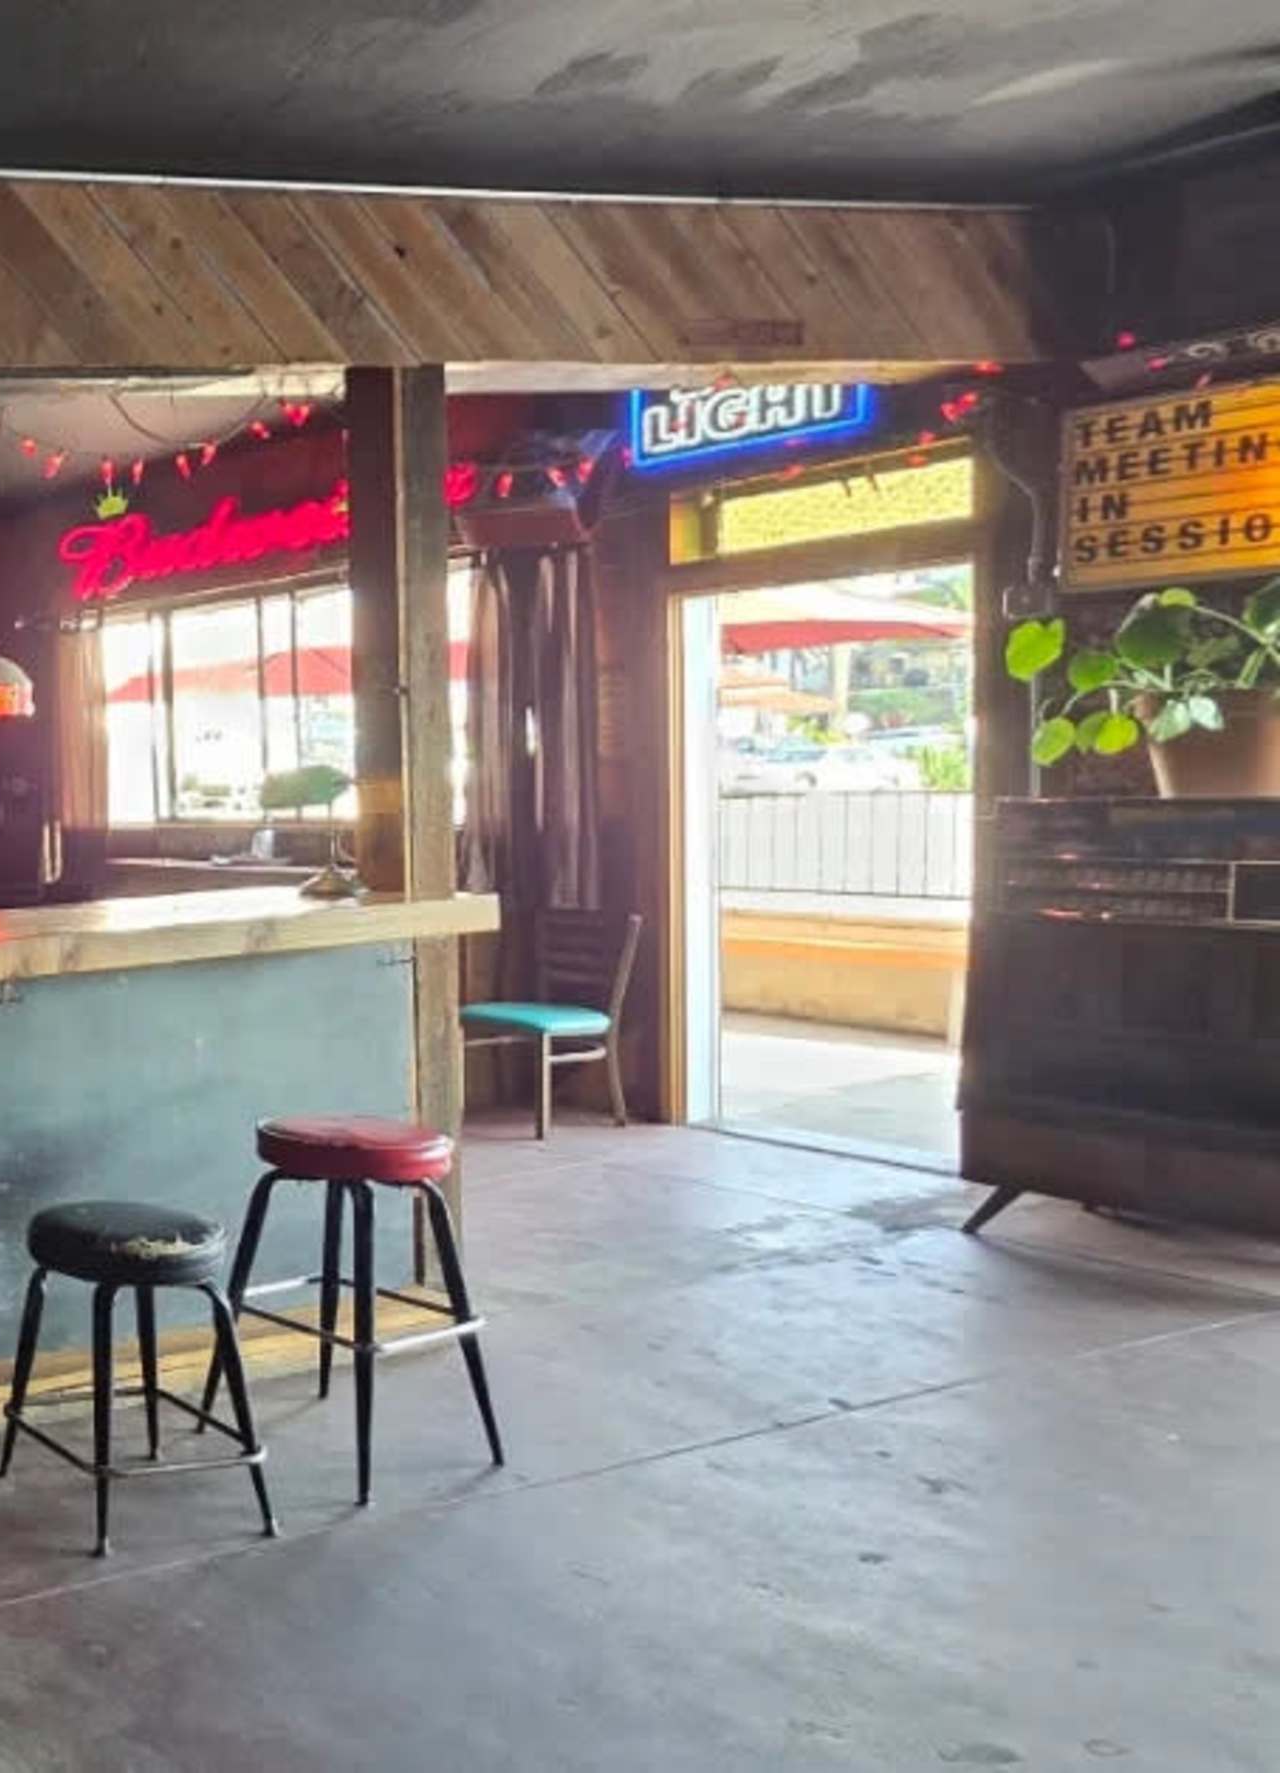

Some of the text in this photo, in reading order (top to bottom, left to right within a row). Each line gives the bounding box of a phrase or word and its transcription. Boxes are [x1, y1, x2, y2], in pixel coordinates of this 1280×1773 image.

[1074, 401, 1212, 447] TEAM
[1077, 492, 1129, 523] IN
[1074, 512, 1272, 563] SESSIO
